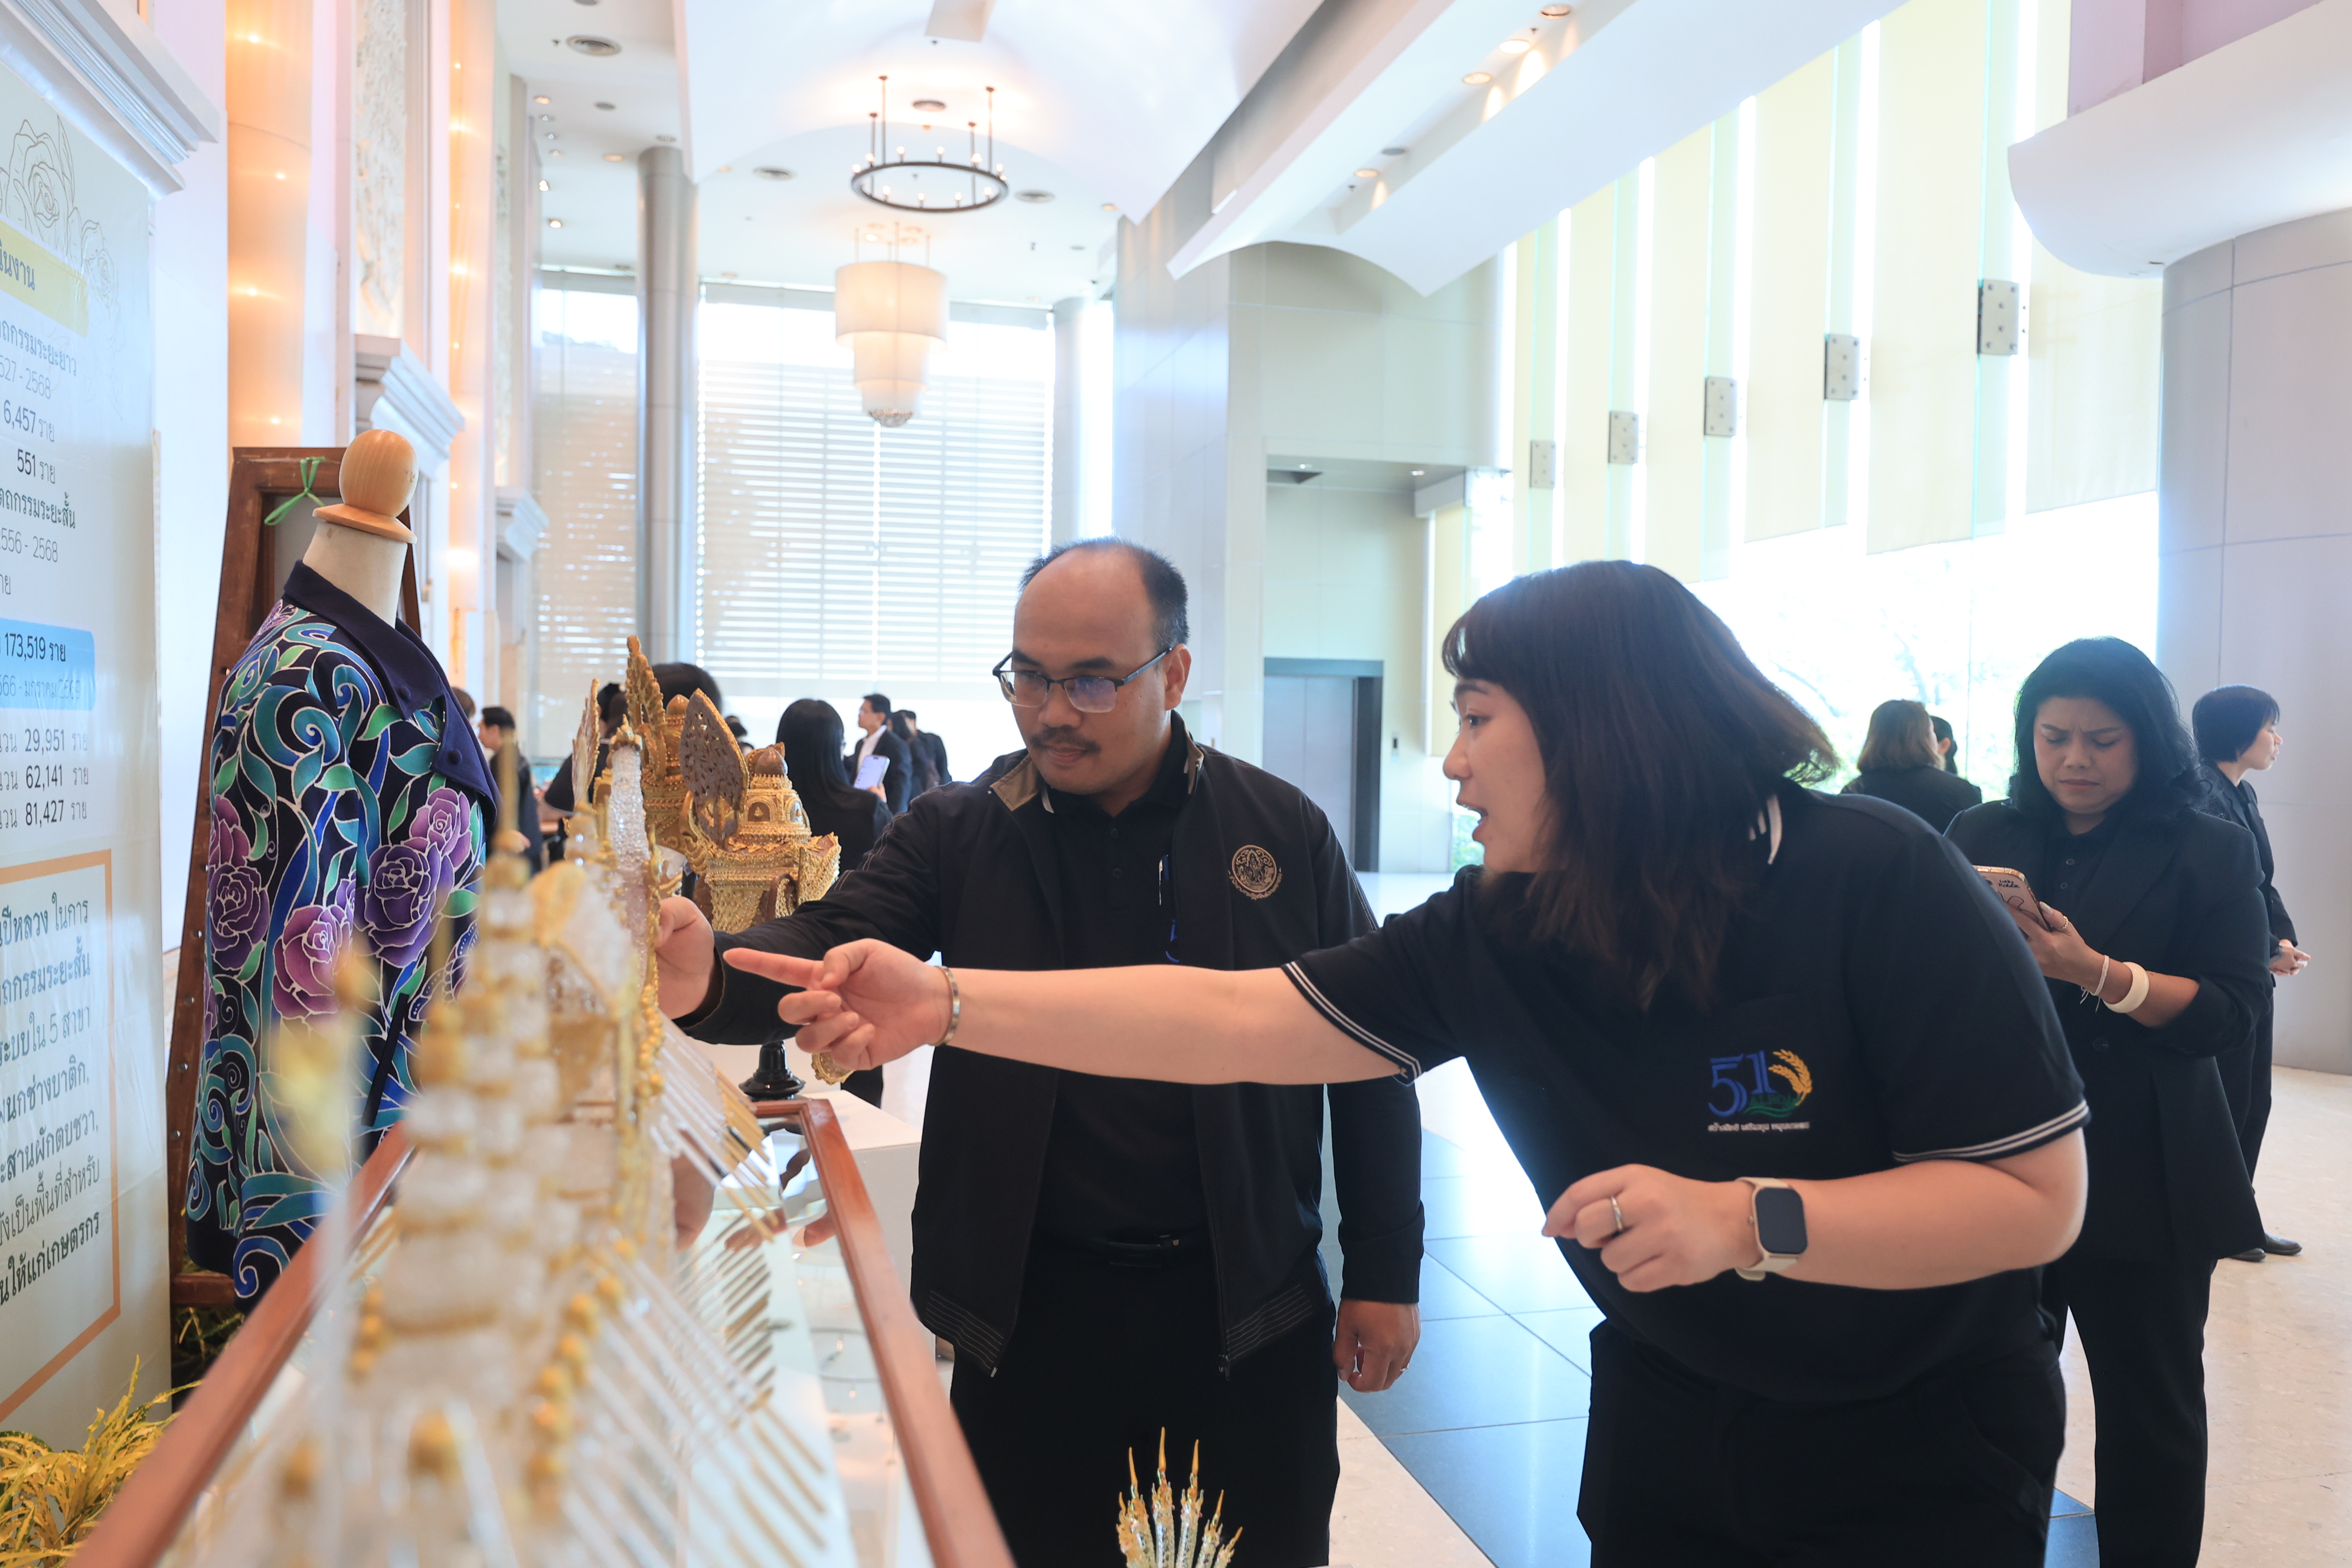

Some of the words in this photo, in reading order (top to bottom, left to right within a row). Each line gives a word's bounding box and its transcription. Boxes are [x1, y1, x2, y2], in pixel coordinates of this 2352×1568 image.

[0, 239, 35, 290] นงาน
[0, 320, 77, 377] ถกรรมระยะยาว
[25, 367, 51, 400] 2568
[4, 399, 36, 434] 6,457
[38, 418, 55, 443] ราย
[17, 448, 35, 477] 551
[40, 461, 56, 484] ราย
[0, 527, 22, 554] 556
[32, 535, 58, 563] 2568
[5, 632, 46, 662] 173,519
[49, 642, 66, 662] ราย
[24, 680, 57, 699] มกราคม
[0, 733, 17, 753] วน
[25, 729, 64, 756] 29,951
[71, 732, 88, 752] ราย
[0, 770, 18, 791] วน
[25, 764, 63, 792] 62,141
[73, 767, 89, 786] ราย
[0, 808, 18, 829] วน
[25, 799, 64, 828] 81,427
[71, 801, 87, 821] ราย
[0, 904, 48, 946] ปีหลวง
[51, 891, 89, 932] ในการ
[0, 935, 90, 1007] ถกรรมระยะสั้น
[49, 1012, 58, 1044] 5
[63, 1005, 90, 1040] สาขา
[1708, 1050, 1778, 1117] 51
[0, 1155, 100, 1247] ังเป็นพื้นที่สำหรับ
